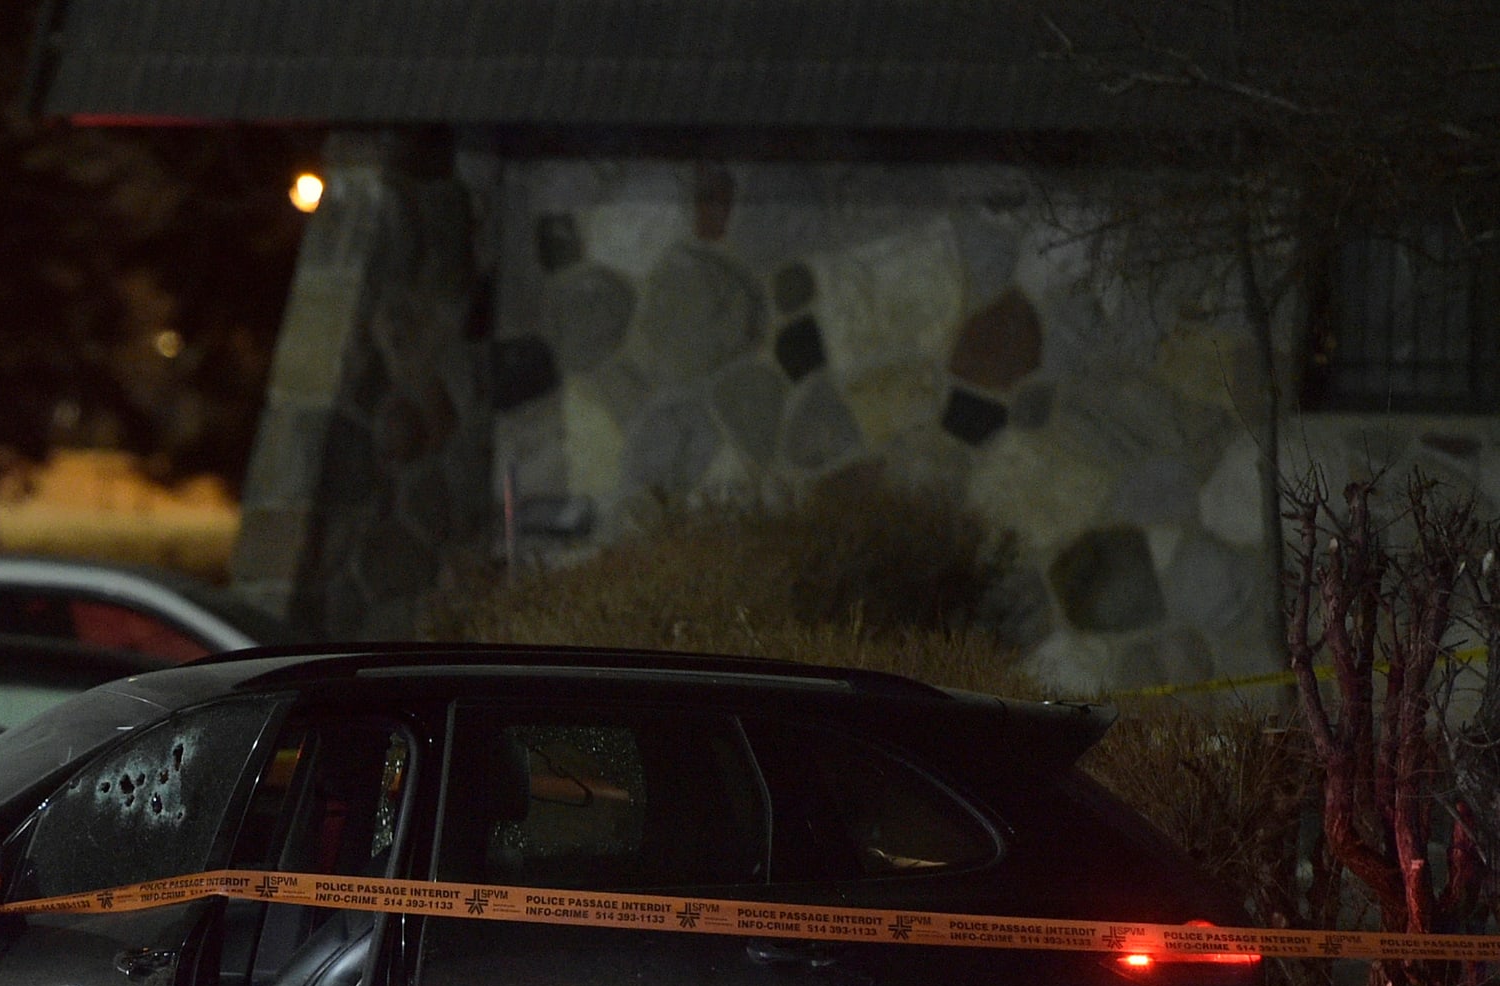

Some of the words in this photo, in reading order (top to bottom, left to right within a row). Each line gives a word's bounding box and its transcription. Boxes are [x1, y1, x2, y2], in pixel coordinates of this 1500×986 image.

[169, 878, 204, 889] PASSAGE
[206, 877, 250, 887] INTERDIT
[270, 877, 298, 887] SPVM
[315, 881, 354, 893] POLICE
[357, 884, 407, 896] PASSAGE
[410, 887, 461, 899] INTERDIT
[315, 893, 378, 905] INFO-CRIME
[384, 897, 403, 907] 514
[406, 898, 453, 910] 393-1133
[480, 889, 509, 900] SPVM
[526, 895, 565, 906] POLICE
[568, 898, 618, 910] PASSAGE
[621, 901, 672, 913] INTERDIT
[692, 902, 720, 913] SPVM
[525, 907, 589, 919] INFO-CRIME
[595, 911, 614, 921] 514
[617, 912, 665, 924] 393-1133
[738, 908, 777, 919] POLICE
[779, 911, 830, 923] PASSAGE
[833, 914, 883, 925] INTERDIT
[738, 919, 801, 932] INFO-CRIME
[807, 924, 826, 934] 514
[950, 920, 989, 932] POLICE
[992, 923, 1042, 934] PASSAGE
[1045, 926, 1096, 937] INTERDIT
[1164, 931, 1205, 941] POLICE
[1206, 933, 1257, 943] PASSAGE
[1260, 935, 1311, 945] INTERDIT
